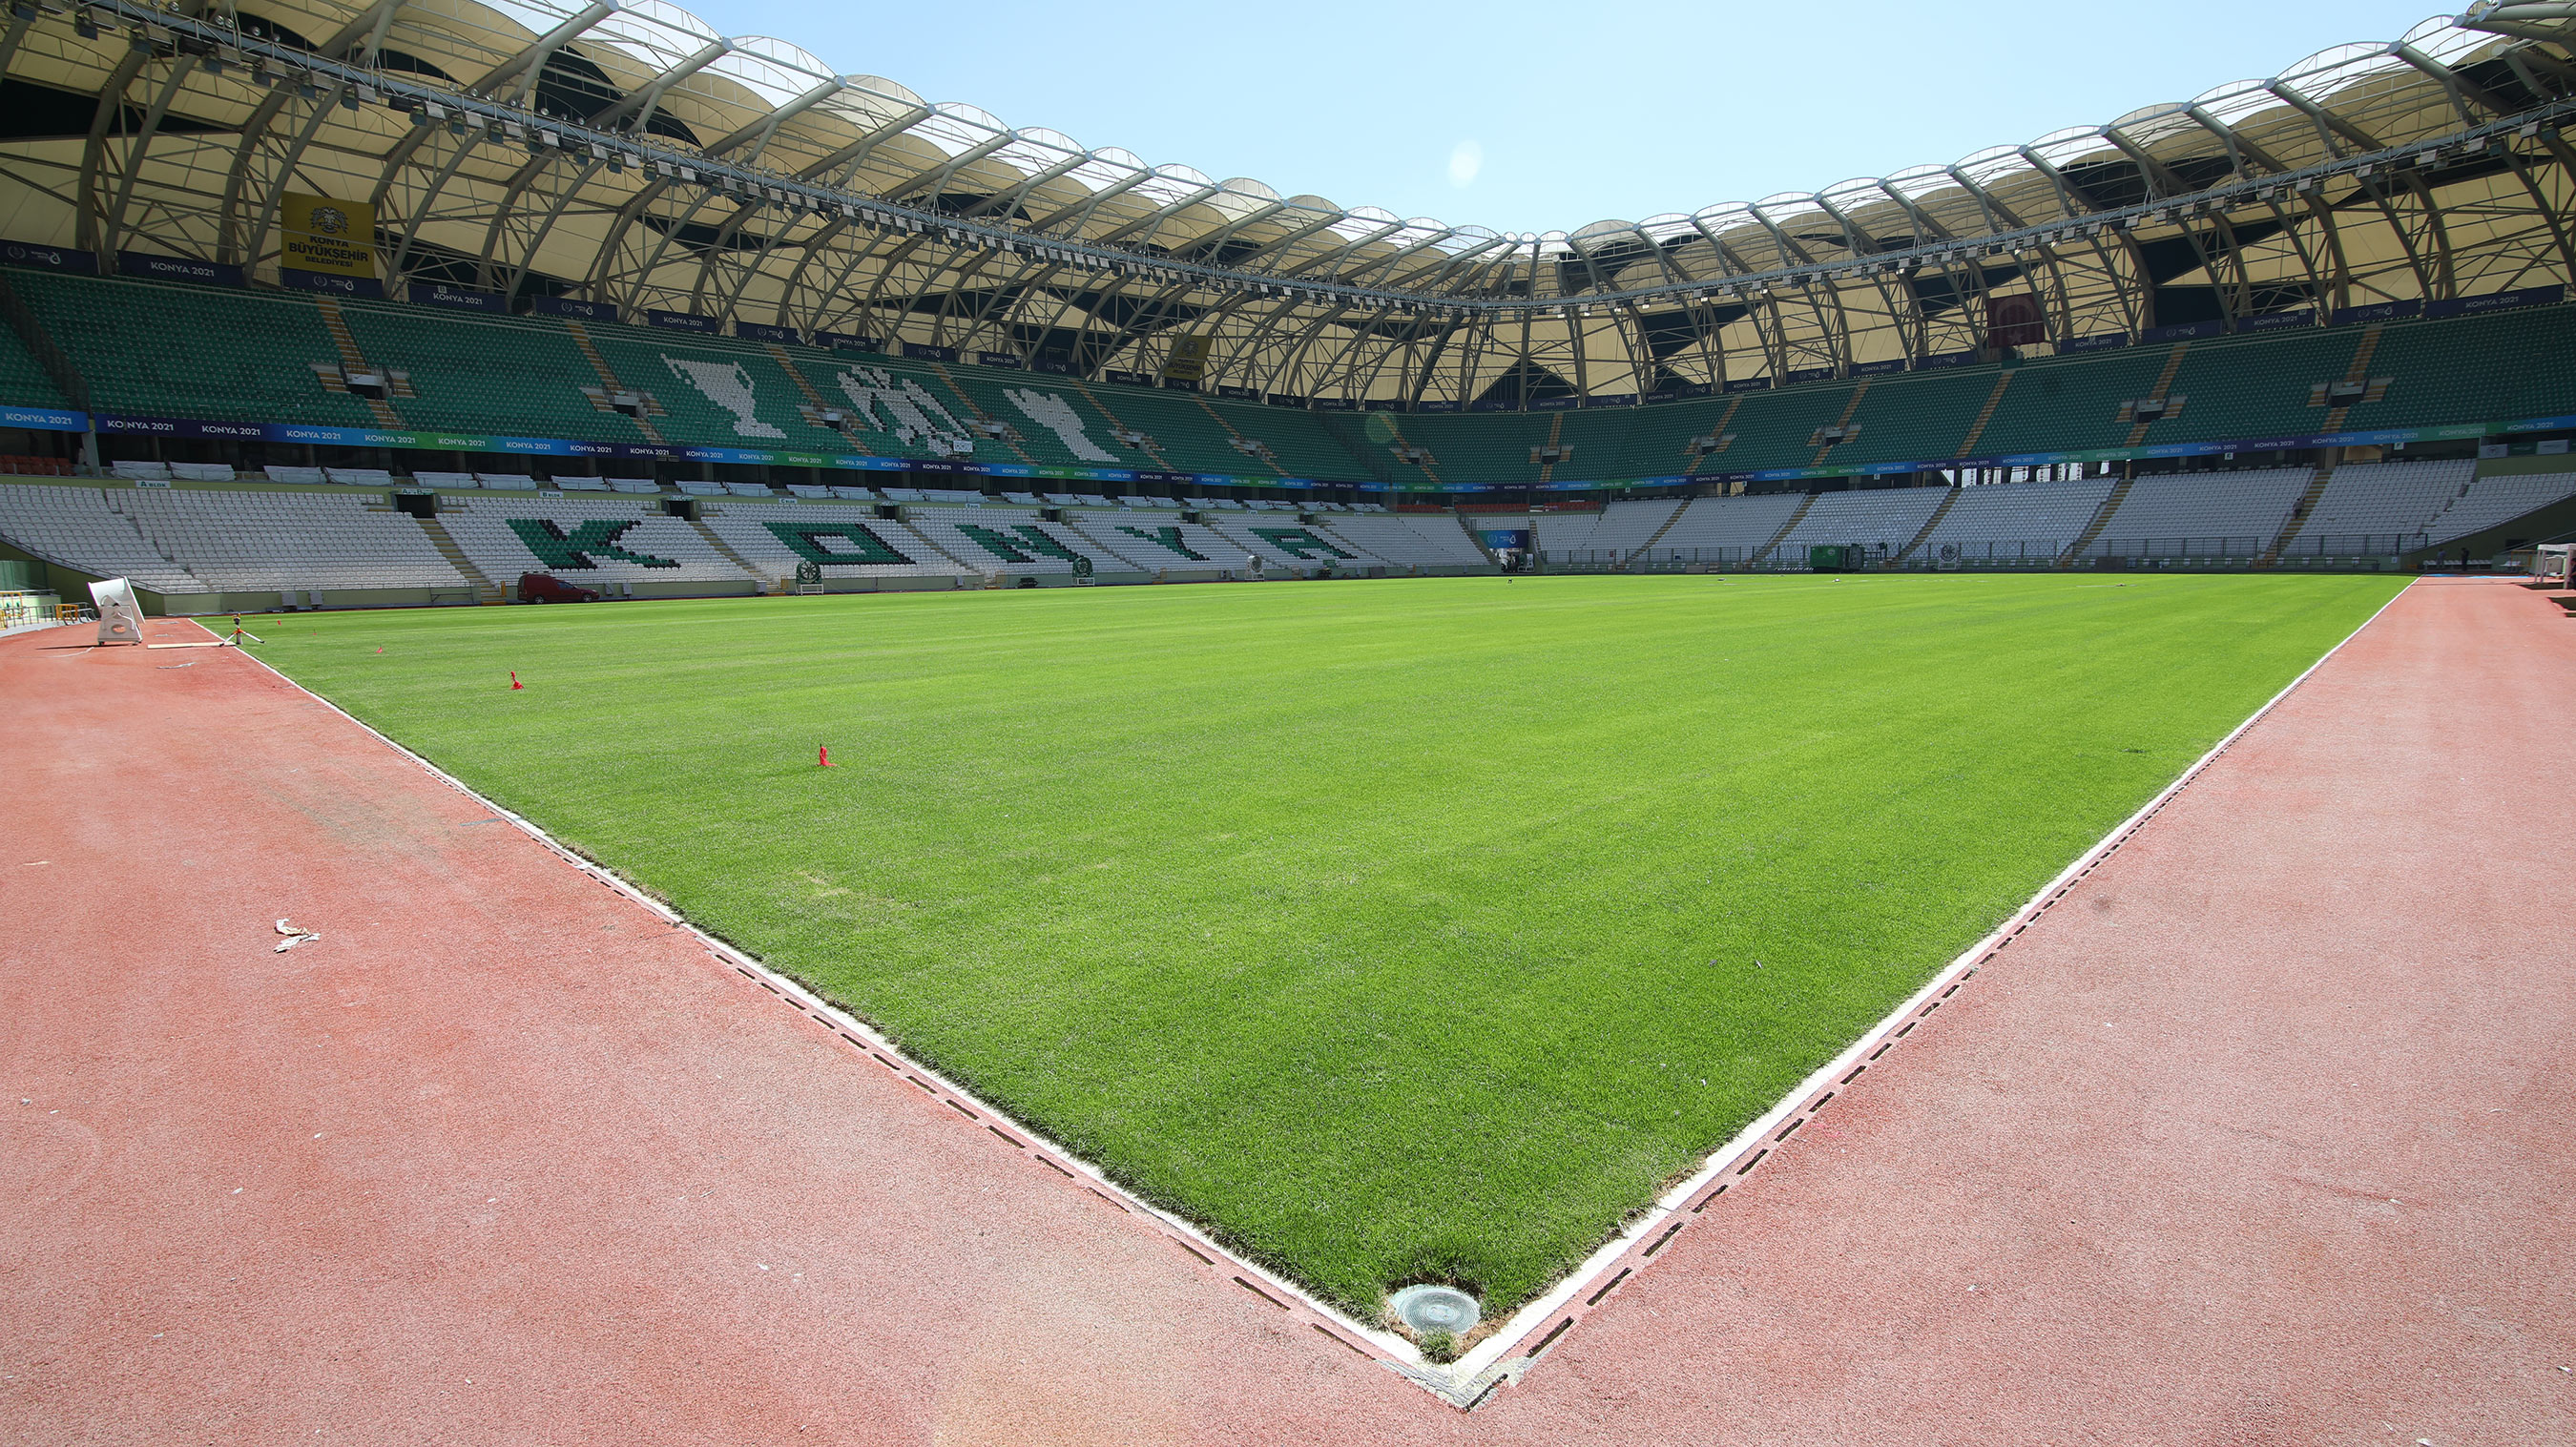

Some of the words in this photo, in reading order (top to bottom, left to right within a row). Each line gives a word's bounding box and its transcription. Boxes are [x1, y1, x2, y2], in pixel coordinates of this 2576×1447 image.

[309, 236, 349, 247] KONYA
[289, 243, 368, 261] BÜYÜKŞEHİR
[151, 262, 189, 274] KONYA
[193, 267, 214, 276] 2021
[433, 293, 463, 303] KONYA
[465, 297, 482, 305] 2021
[2466, 300, 2497, 308] KONYA
[5, 412, 45, 422] KONYA
[48, 415, 71, 424] 2021
[107, 419, 148, 429] KONYA
[151, 422, 173, 431] 2021
[201, 425, 237, 434] KONYA
[239, 427, 260, 435] 2021
[286, 430, 319, 438] KONYA
[321, 431, 340, 439] 2021
[2438, 428, 2467, 436] KONYA
[364, 434, 395, 442] KONYA
